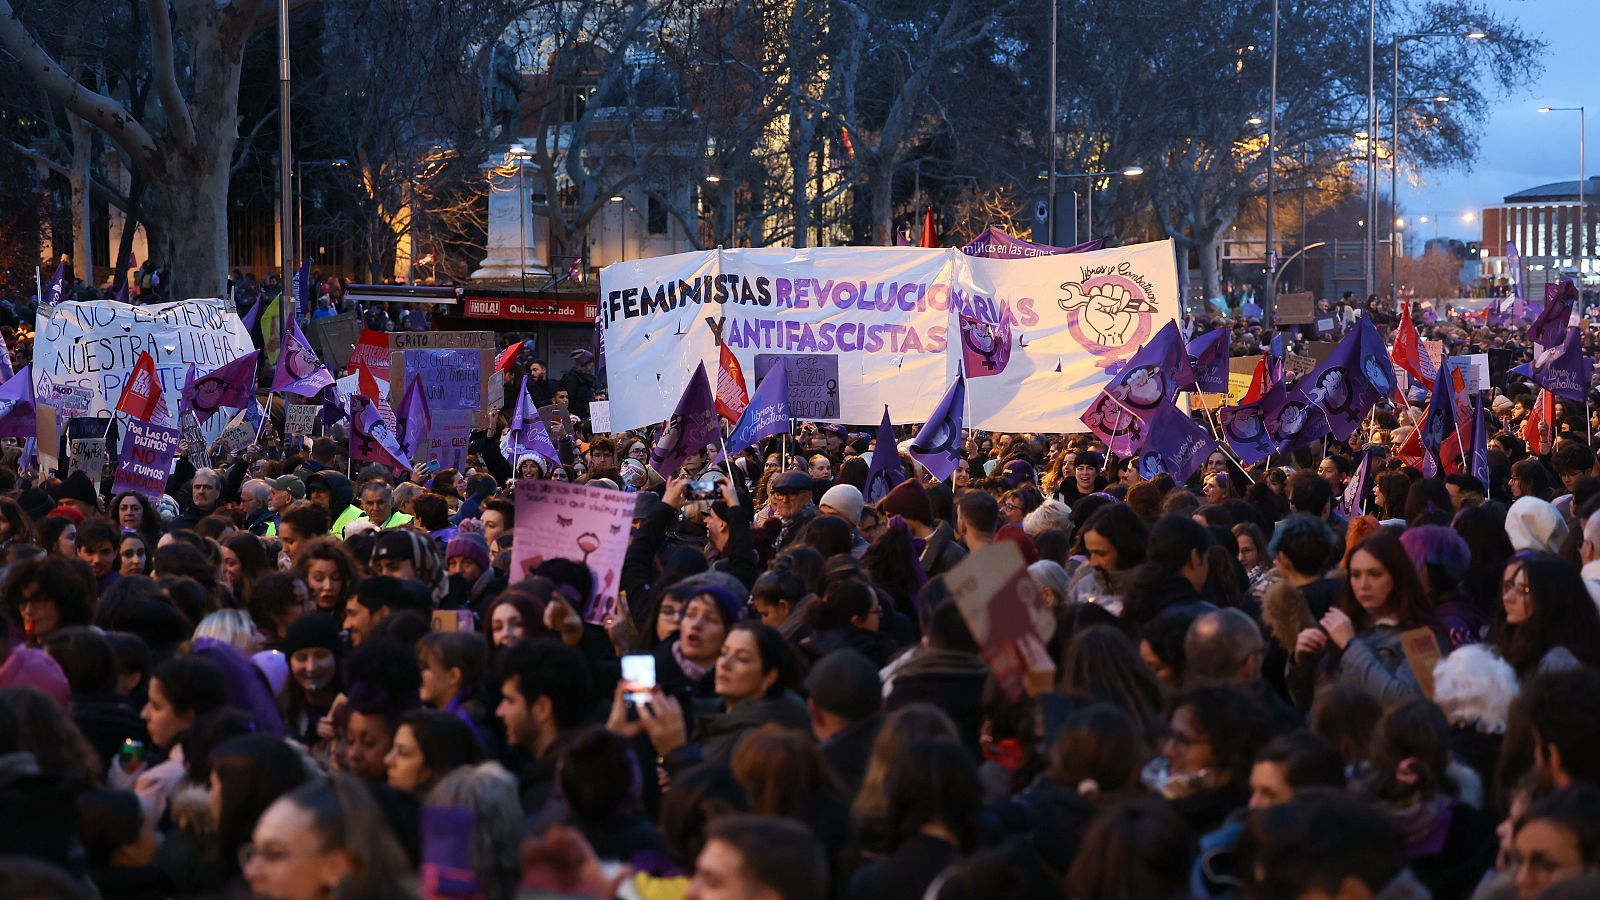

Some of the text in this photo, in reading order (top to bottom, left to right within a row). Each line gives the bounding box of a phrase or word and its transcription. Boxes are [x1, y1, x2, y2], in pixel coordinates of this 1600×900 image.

[997, 243, 1007, 254] en
[1008, 242, 1022, 256] las
[471, 301, 499, 314] ¡HOLA!
[775, 277, 1040, 327] REVOLUCIONARIAS
[75, 304, 116, 332] NO
[705, 316, 948, 353] Y ANTIFASCISTAS
[55, 331, 238, 376] NUESTRA LUCHA
[104, 366, 184, 402] PTE
[1541, 376, 1583, 391] Cmbativas
[788, 400, 835, 418] RIARCADO
[134, 435, 168, 452] DIJIMOS
[130, 447, 157, 465] NO
[122, 460, 165, 480] Y FUIMOS
